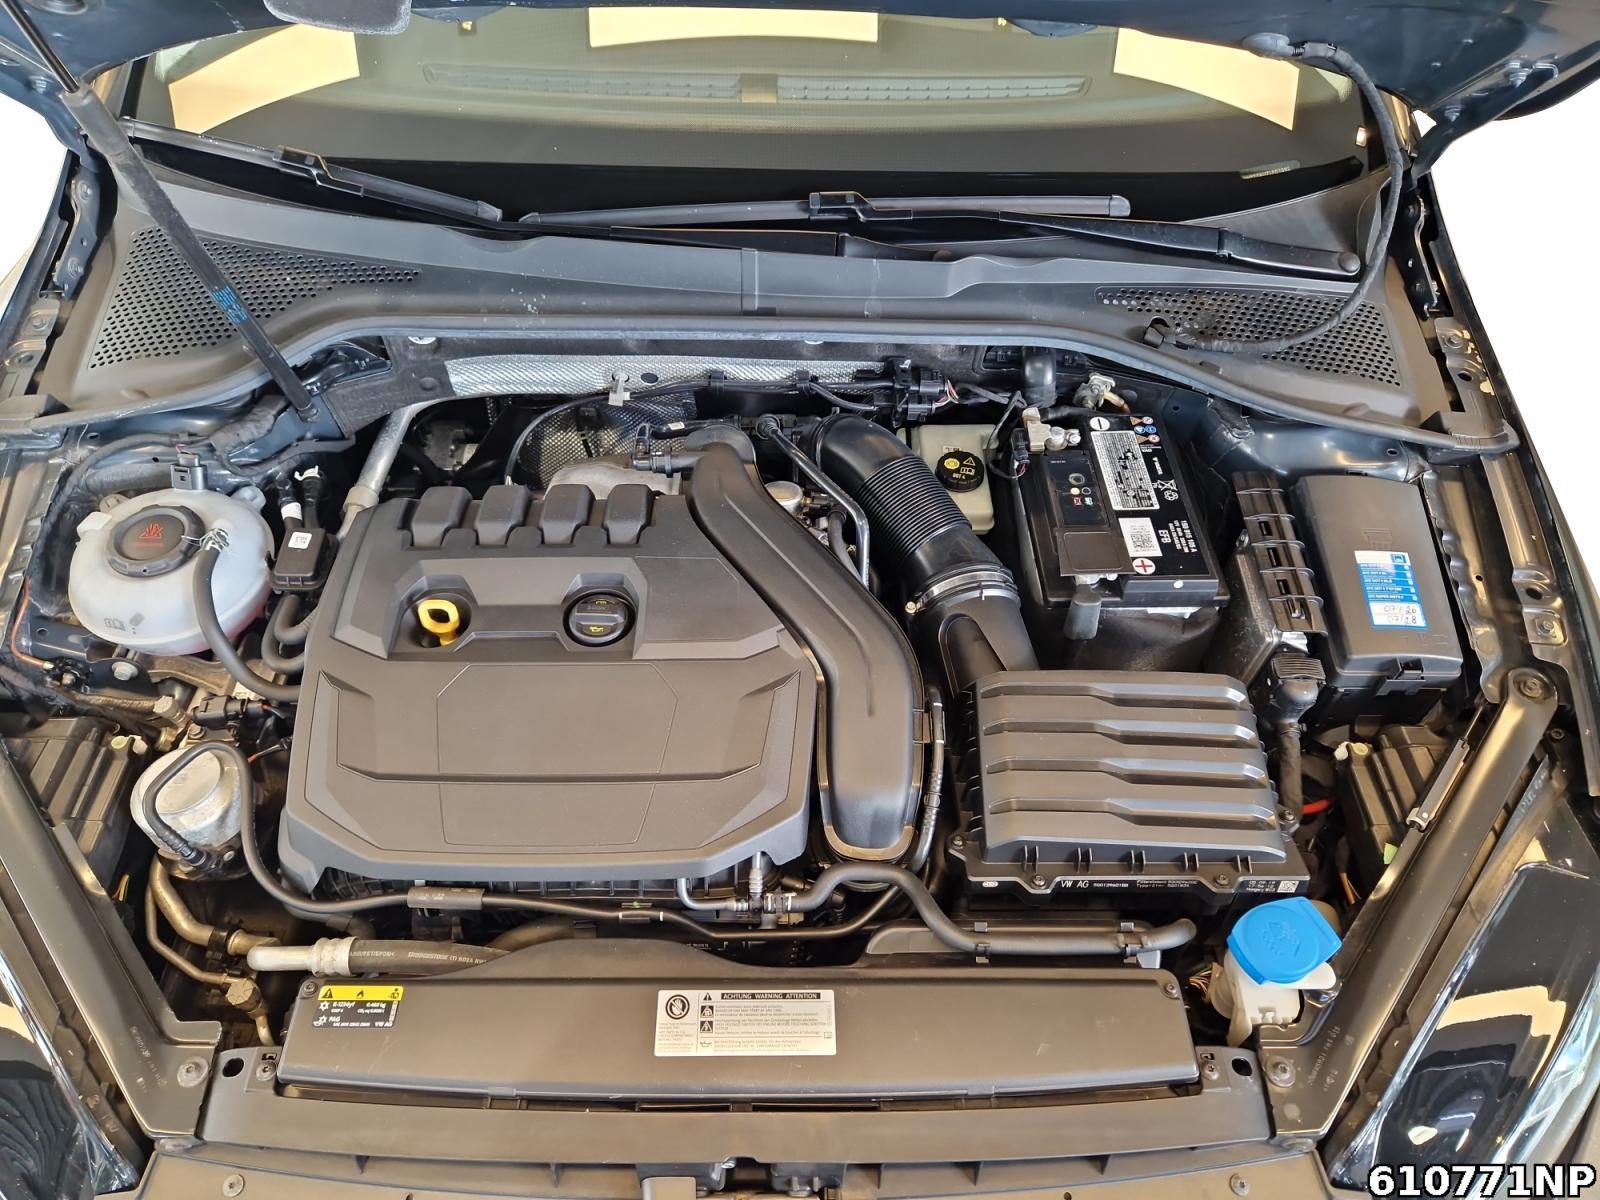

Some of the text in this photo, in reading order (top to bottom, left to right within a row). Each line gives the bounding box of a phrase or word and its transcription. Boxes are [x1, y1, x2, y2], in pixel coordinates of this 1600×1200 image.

[1158, 529, 1172, 544] EFB
[1061, 880, 1090, 888] VW AG
